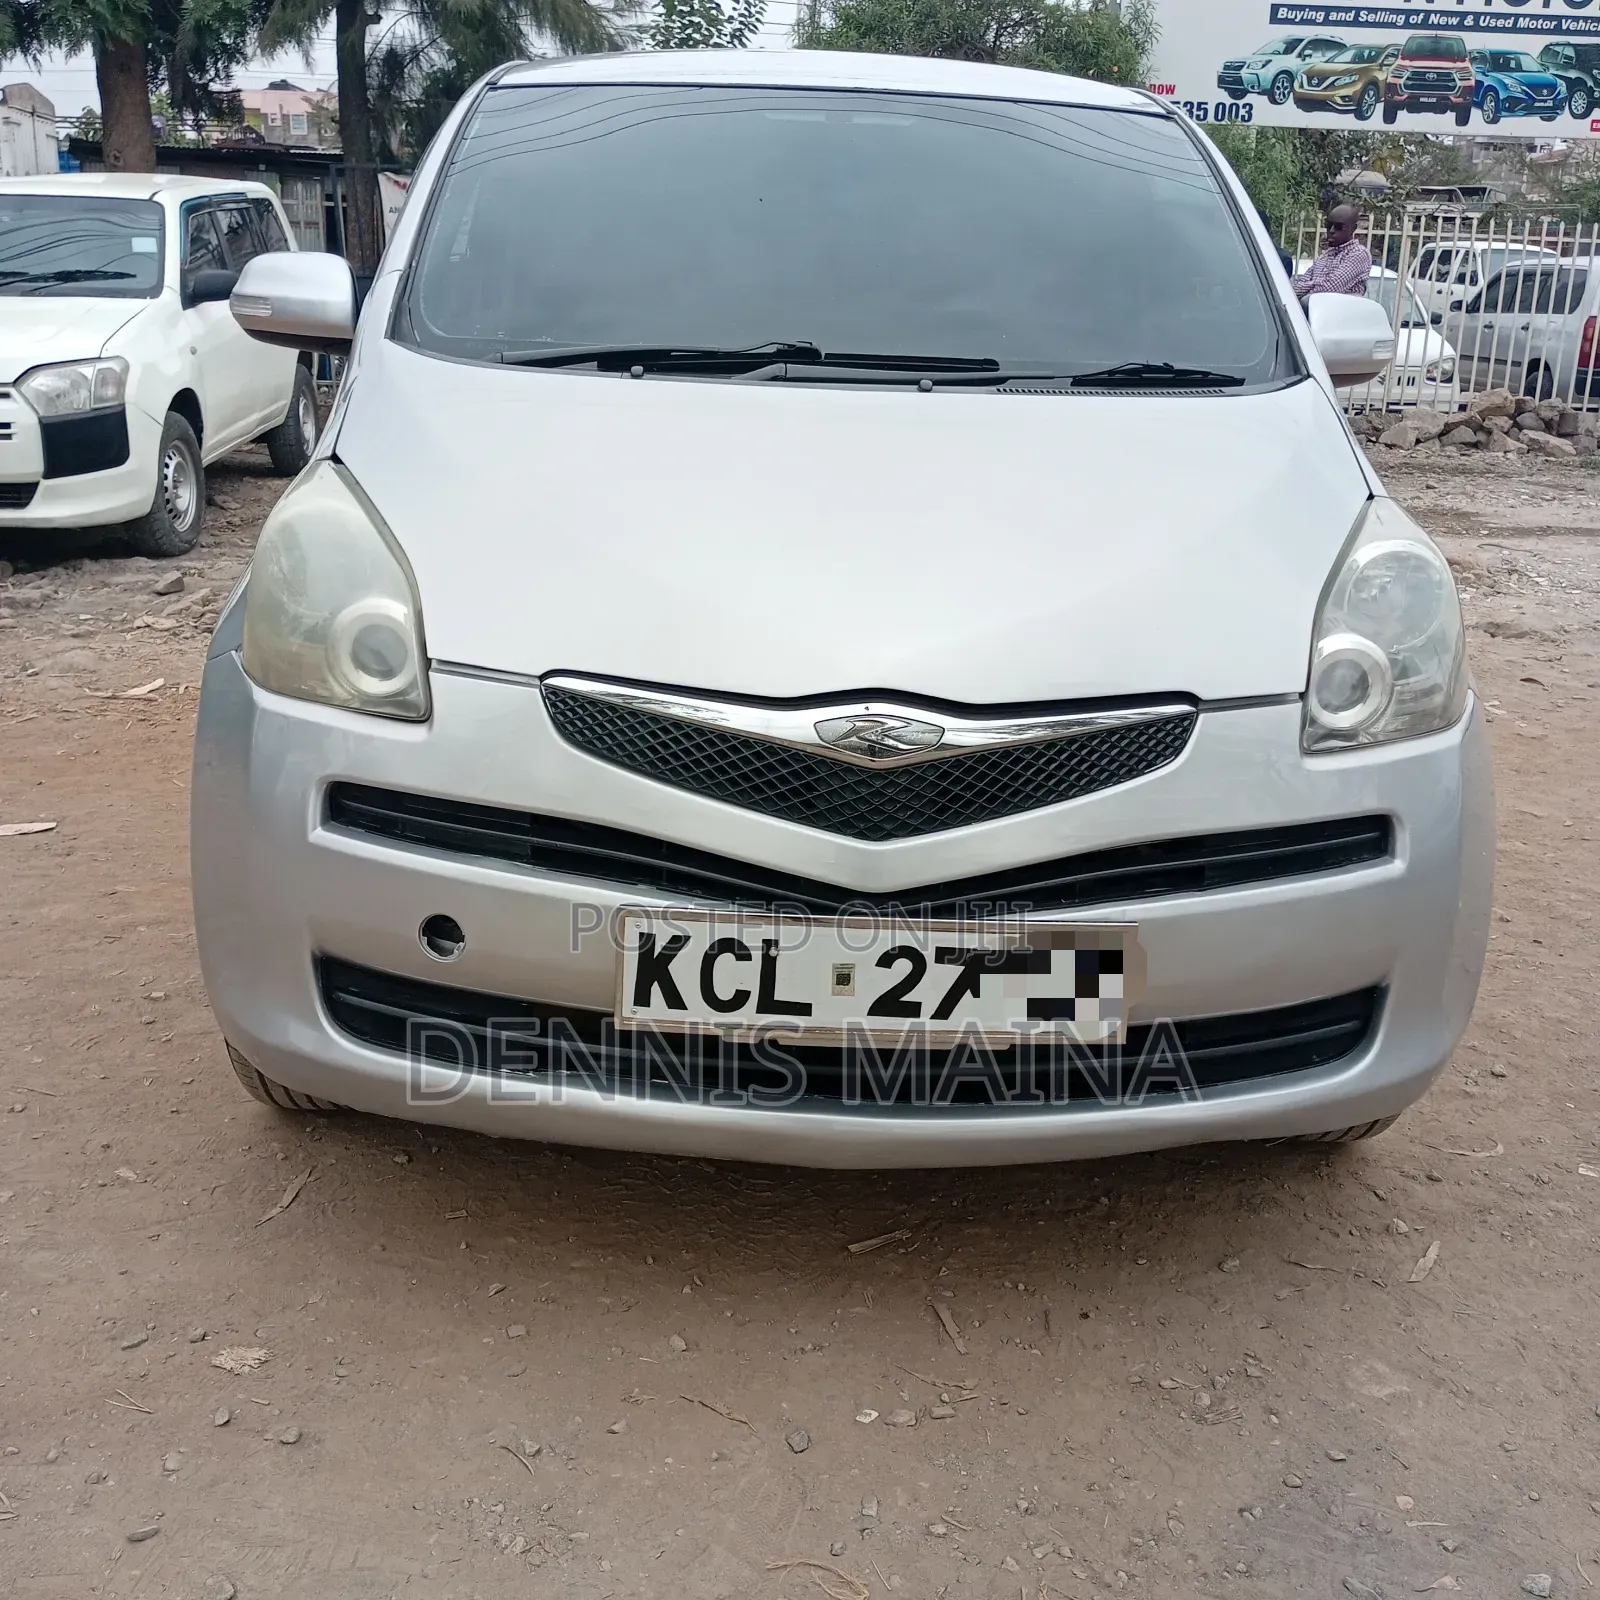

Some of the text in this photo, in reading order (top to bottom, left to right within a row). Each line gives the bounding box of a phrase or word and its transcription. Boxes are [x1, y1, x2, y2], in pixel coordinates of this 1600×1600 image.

[1277, 7, 1325, 23] Buying
[1328, 9, 1355, 22] and
[1358, 10, 1405, 26] Selling
[1409, 12, 1425, 24] of
[1428, 13, 1460, 26] New
[1463, 14, 1475, 27] &
[1479, 15, 1514, 29] Used
[1516, 17, 1557, 31] Motor
[1213, 102, 1254, 123] 003
[633, 931, 813, 1017] KCL
